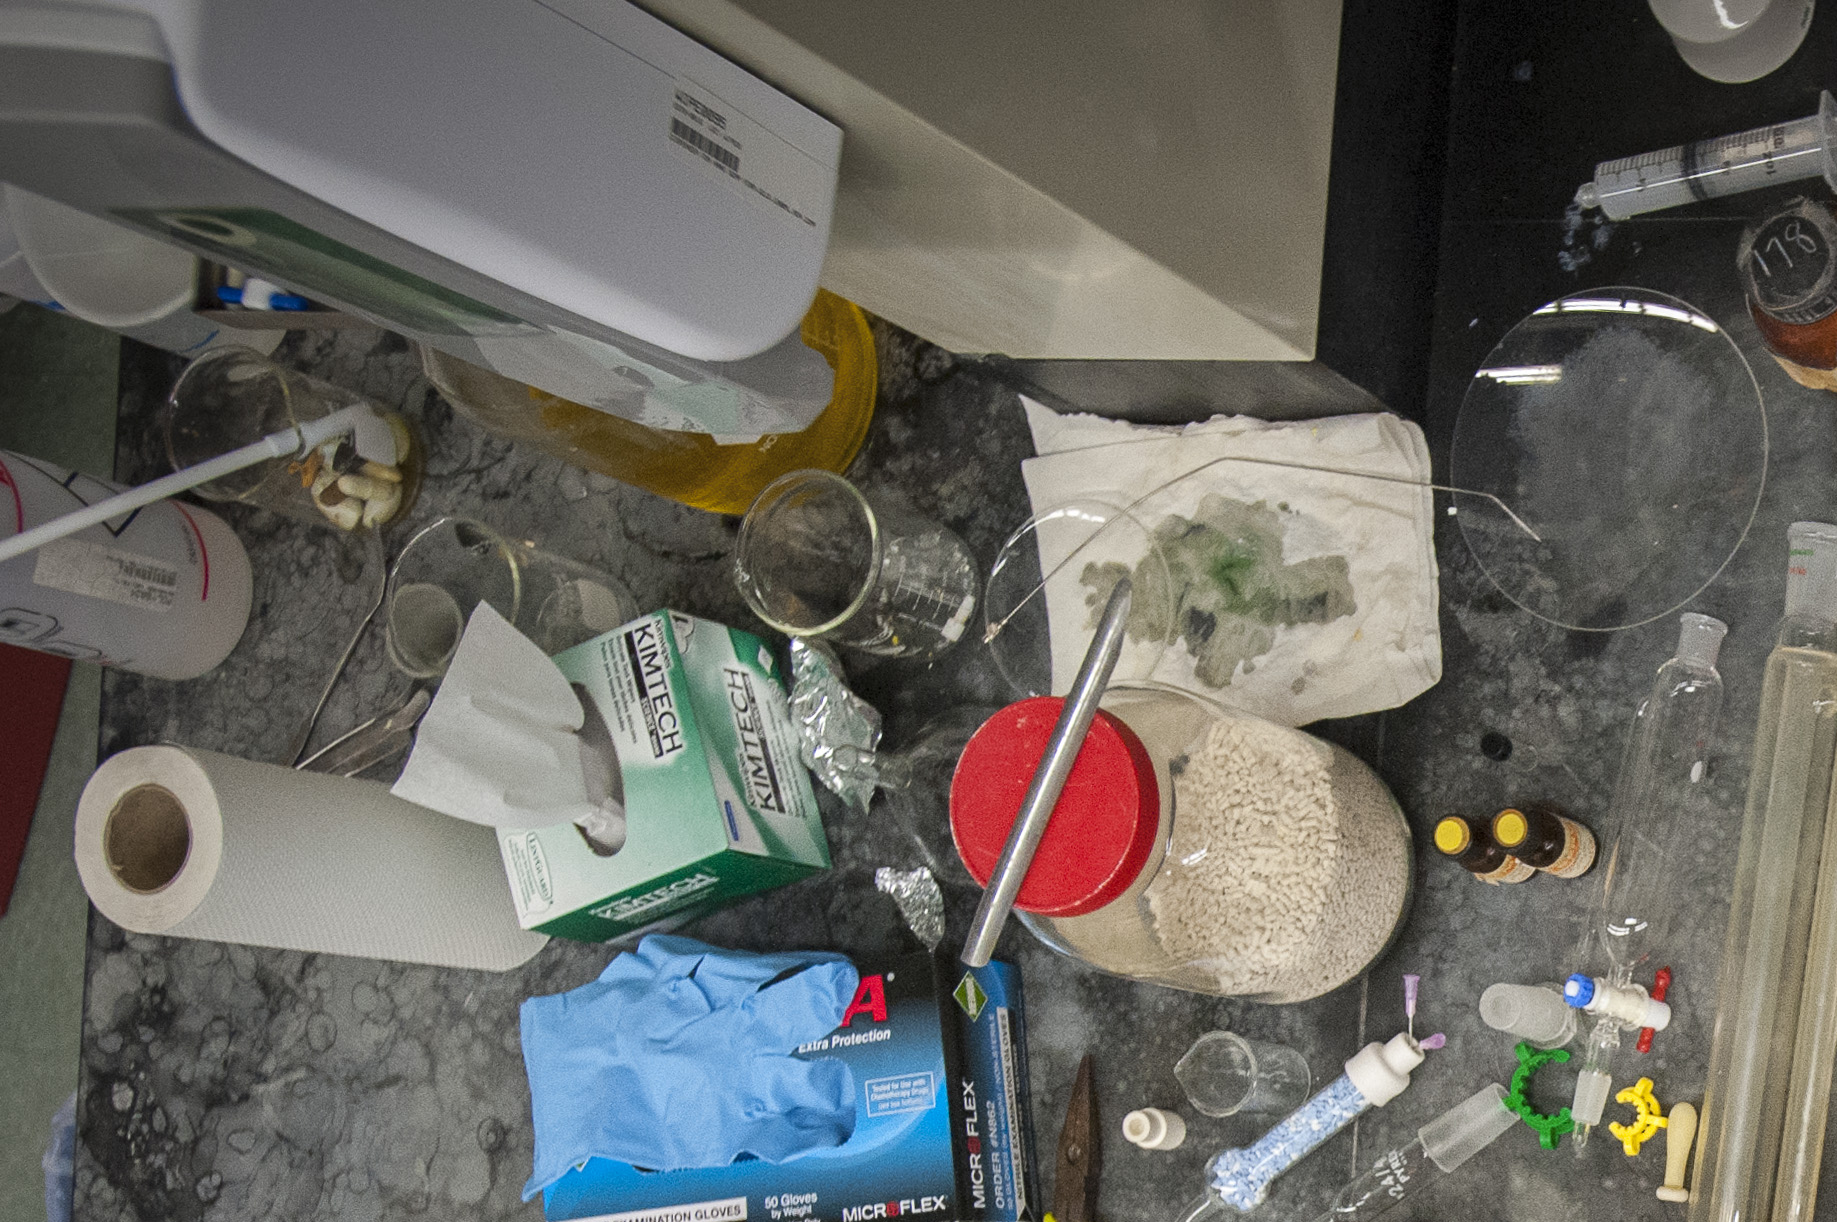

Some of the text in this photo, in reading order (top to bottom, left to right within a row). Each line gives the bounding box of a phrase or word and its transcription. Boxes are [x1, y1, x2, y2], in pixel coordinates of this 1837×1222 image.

[1754, 222, 1817, 278] 178
[634, 622, 683, 753] KIMTECH
[724, 667, 777, 813] KIMTECH
[831, 1028, 892, 1051] Protection
[962, 1079, 986, 1210] MICROFLEX
[764, 1191, 818, 1209] 50 Gloves
[991, 1152, 1006, 1209] ORDER
[695, 1204, 742, 1222] GLOVES
[770, 1203, 813, 1220] by Weight
